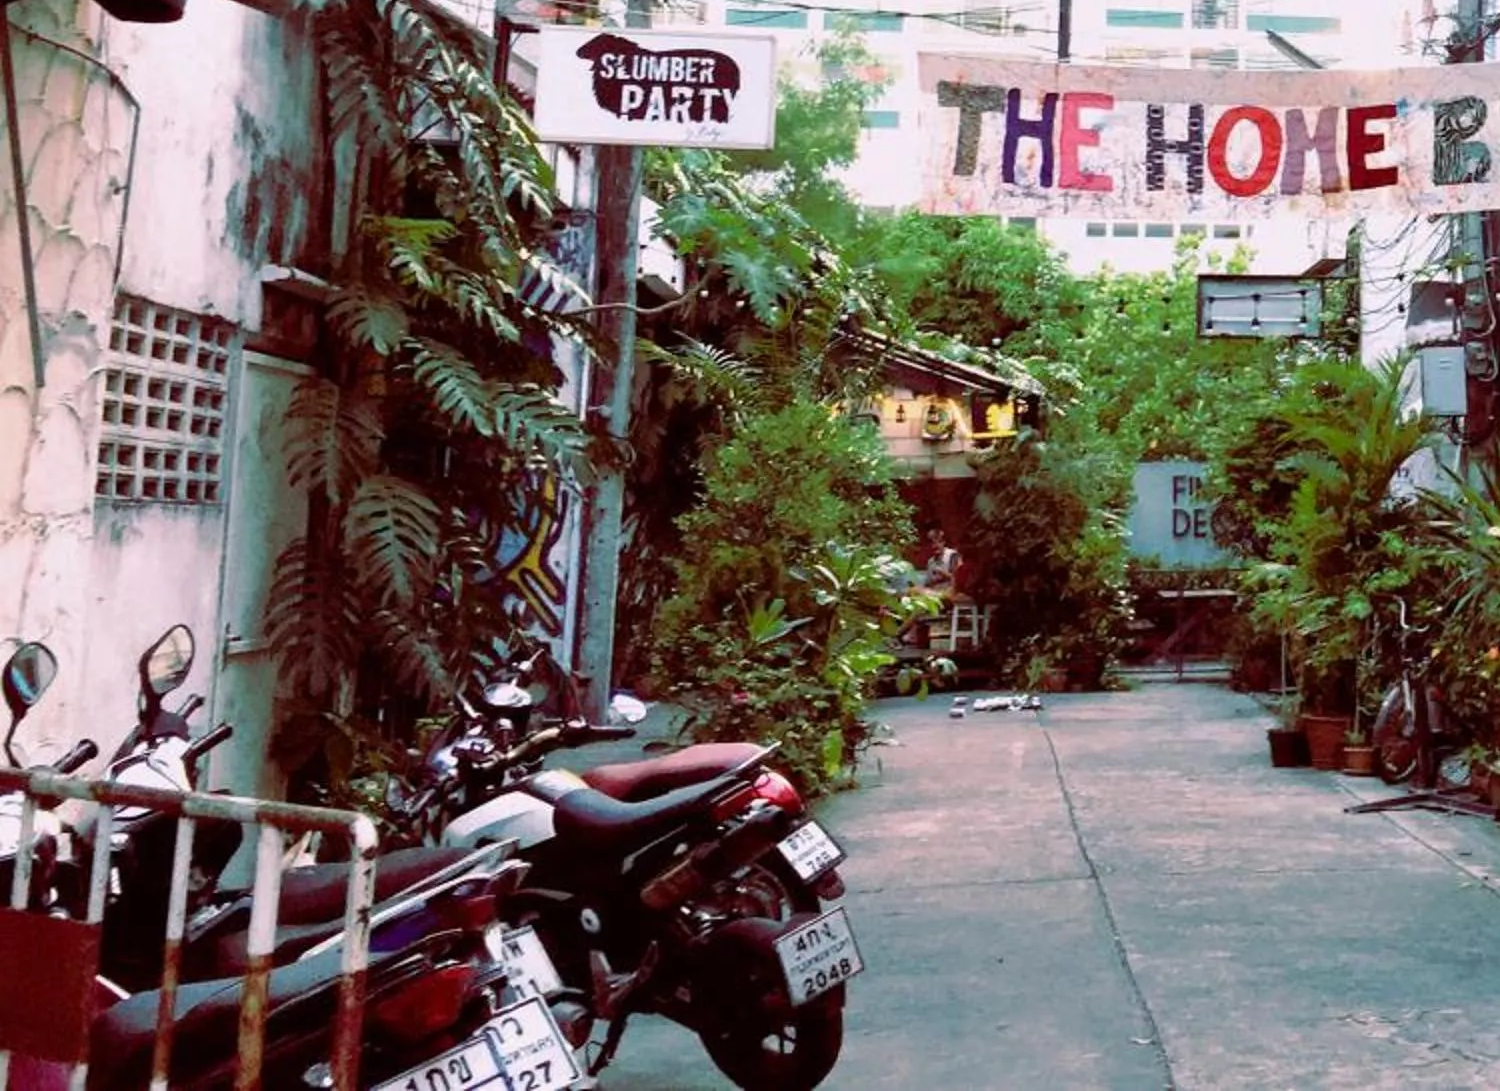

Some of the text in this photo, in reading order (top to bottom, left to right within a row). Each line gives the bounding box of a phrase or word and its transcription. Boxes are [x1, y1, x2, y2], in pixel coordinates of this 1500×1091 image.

[600, 53, 716, 84] SLUMBER
[619, 84, 740, 122] PARTY
[937, 80, 1114, 192] THE
[1146, 103, 1398, 197] HOME
[803, 957, 851, 998] 2048
